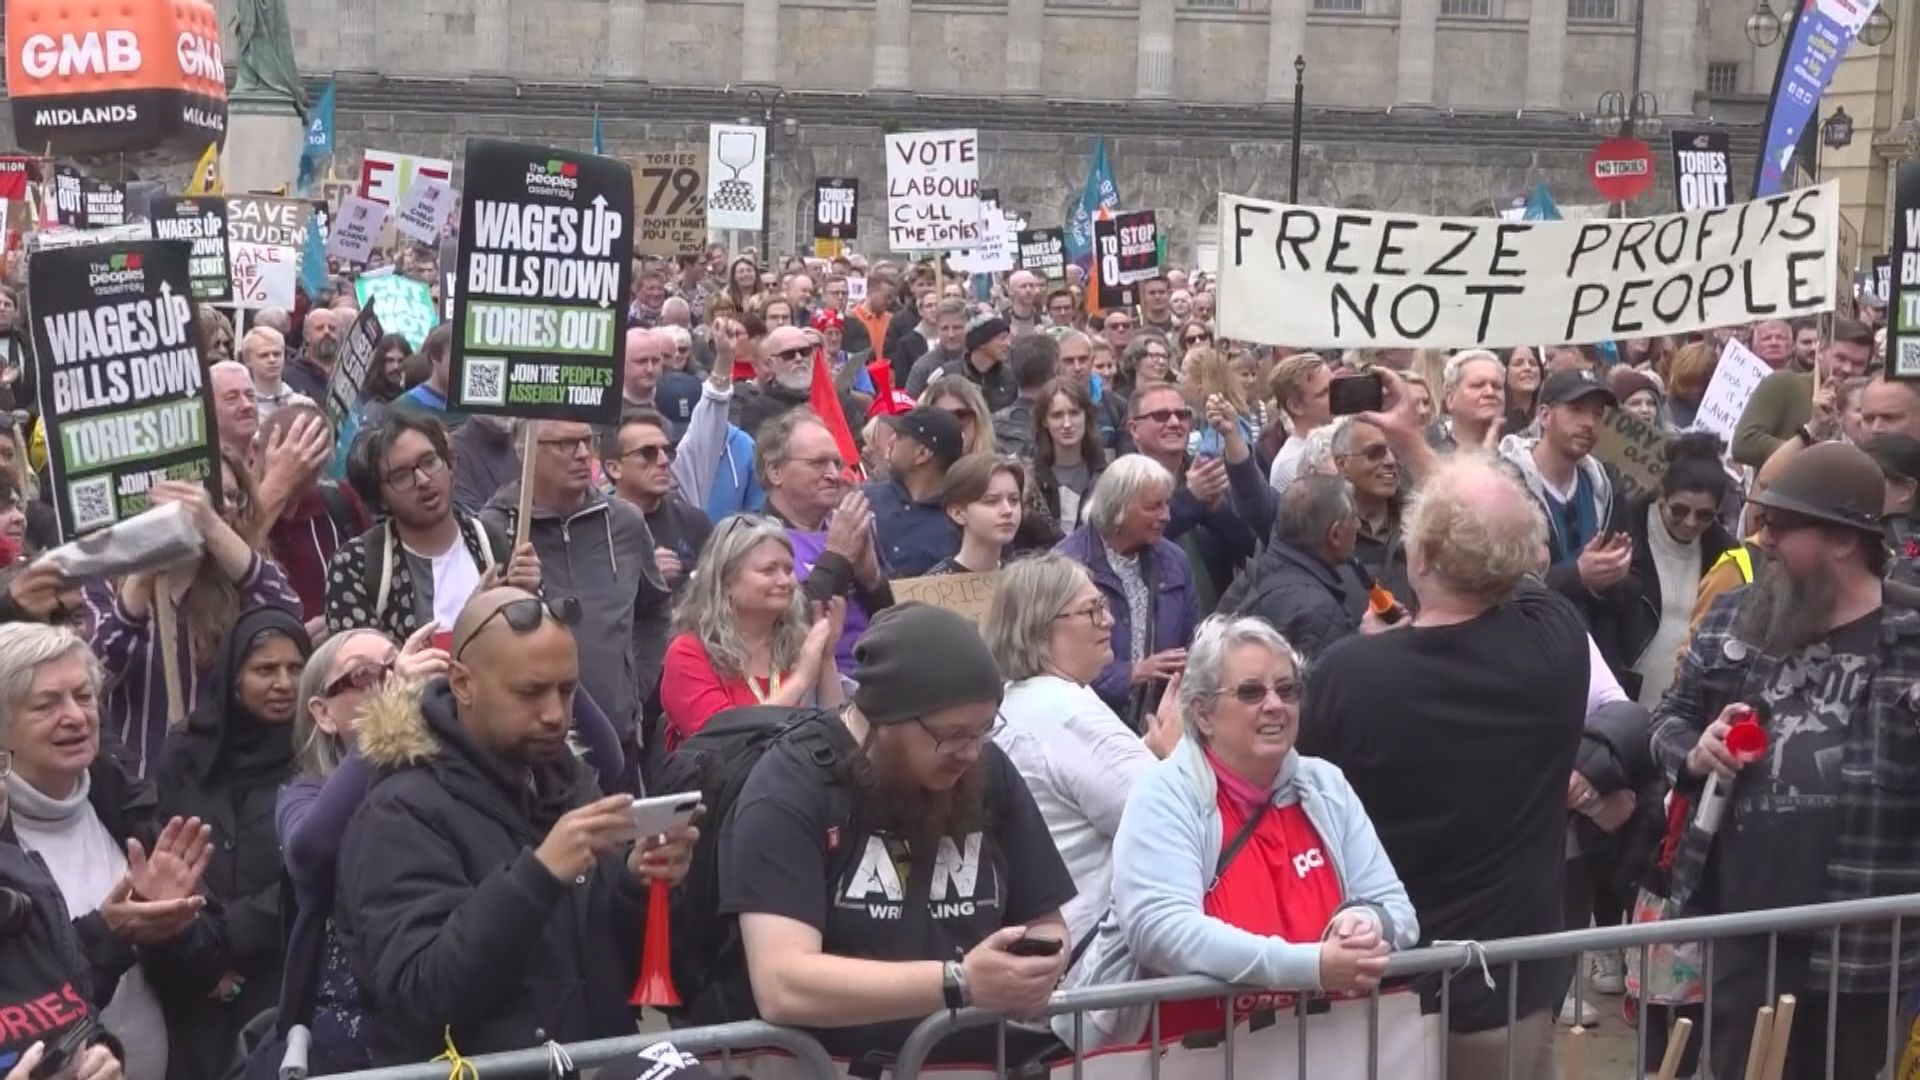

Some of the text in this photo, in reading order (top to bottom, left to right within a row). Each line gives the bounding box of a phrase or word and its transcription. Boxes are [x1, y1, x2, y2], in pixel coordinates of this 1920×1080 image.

[22, 30, 142, 78] GMB
[35, 105, 137, 125] MIDLANDS
[646, 154, 696, 165] TORIES
[895, 138, 975, 165] VOTE
[1678, 150, 1726, 174] TORIES
[529, 161, 545, 173] the
[1598, 163, 1611, 173] NO
[526, 172, 578, 189] peoples
[642, 167, 704, 215] 79%
[889, 176, 980, 197] LABOUR
[1680, 174, 1727, 210] OUT
[59, 188, 81, 213] OUT
[528, 185, 575, 201] assembly
[819, 188, 854, 202] TORIES
[227, 199, 298, 226] SAVE
[818, 201, 854, 225] OUT
[895, 203, 952, 223] CULL
[155, 210, 222, 240] WAGES UP
[475, 195, 622, 256] WAGES UP
[890, 226, 926, 243] THE
[1121, 224, 1155, 245] STOP
[1235, 203, 1534, 275] FREEZE
[1567, 190, 1820, 277] PROFITS
[90, 262, 109, 273] the
[201, 258, 225, 276] OUT
[236, 248, 281, 264] ARE
[89, 268, 145, 287] peoples
[232, 264, 257, 277] HE
[468, 253, 540, 296] BILLS
[543, 258, 619, 306] DOWN
[1331, 282, 1525, 344] NOT
[1565, 250, 1825, 340] PEOPLE
[44, 280, 191, 365] WAGES UP
[471, 306, 557, 348] TORIES
[560, 311, 612, 351] OUT
[53, 347, 203, 415] BILLS DOWN
[510, 364, 613, 386] JOIN THE PEOPLE'S
[509, 384, 604, 405] ASSEMBLY TODAY
[1703, 397, 1737, 429] LAVAT
[65, 403, 200, 467] TORIES OUT
[118, 472, 152, 495] JOIN
[902, 576, 993, 606] TORIES
[0, 981, 87, 1044] RIES
